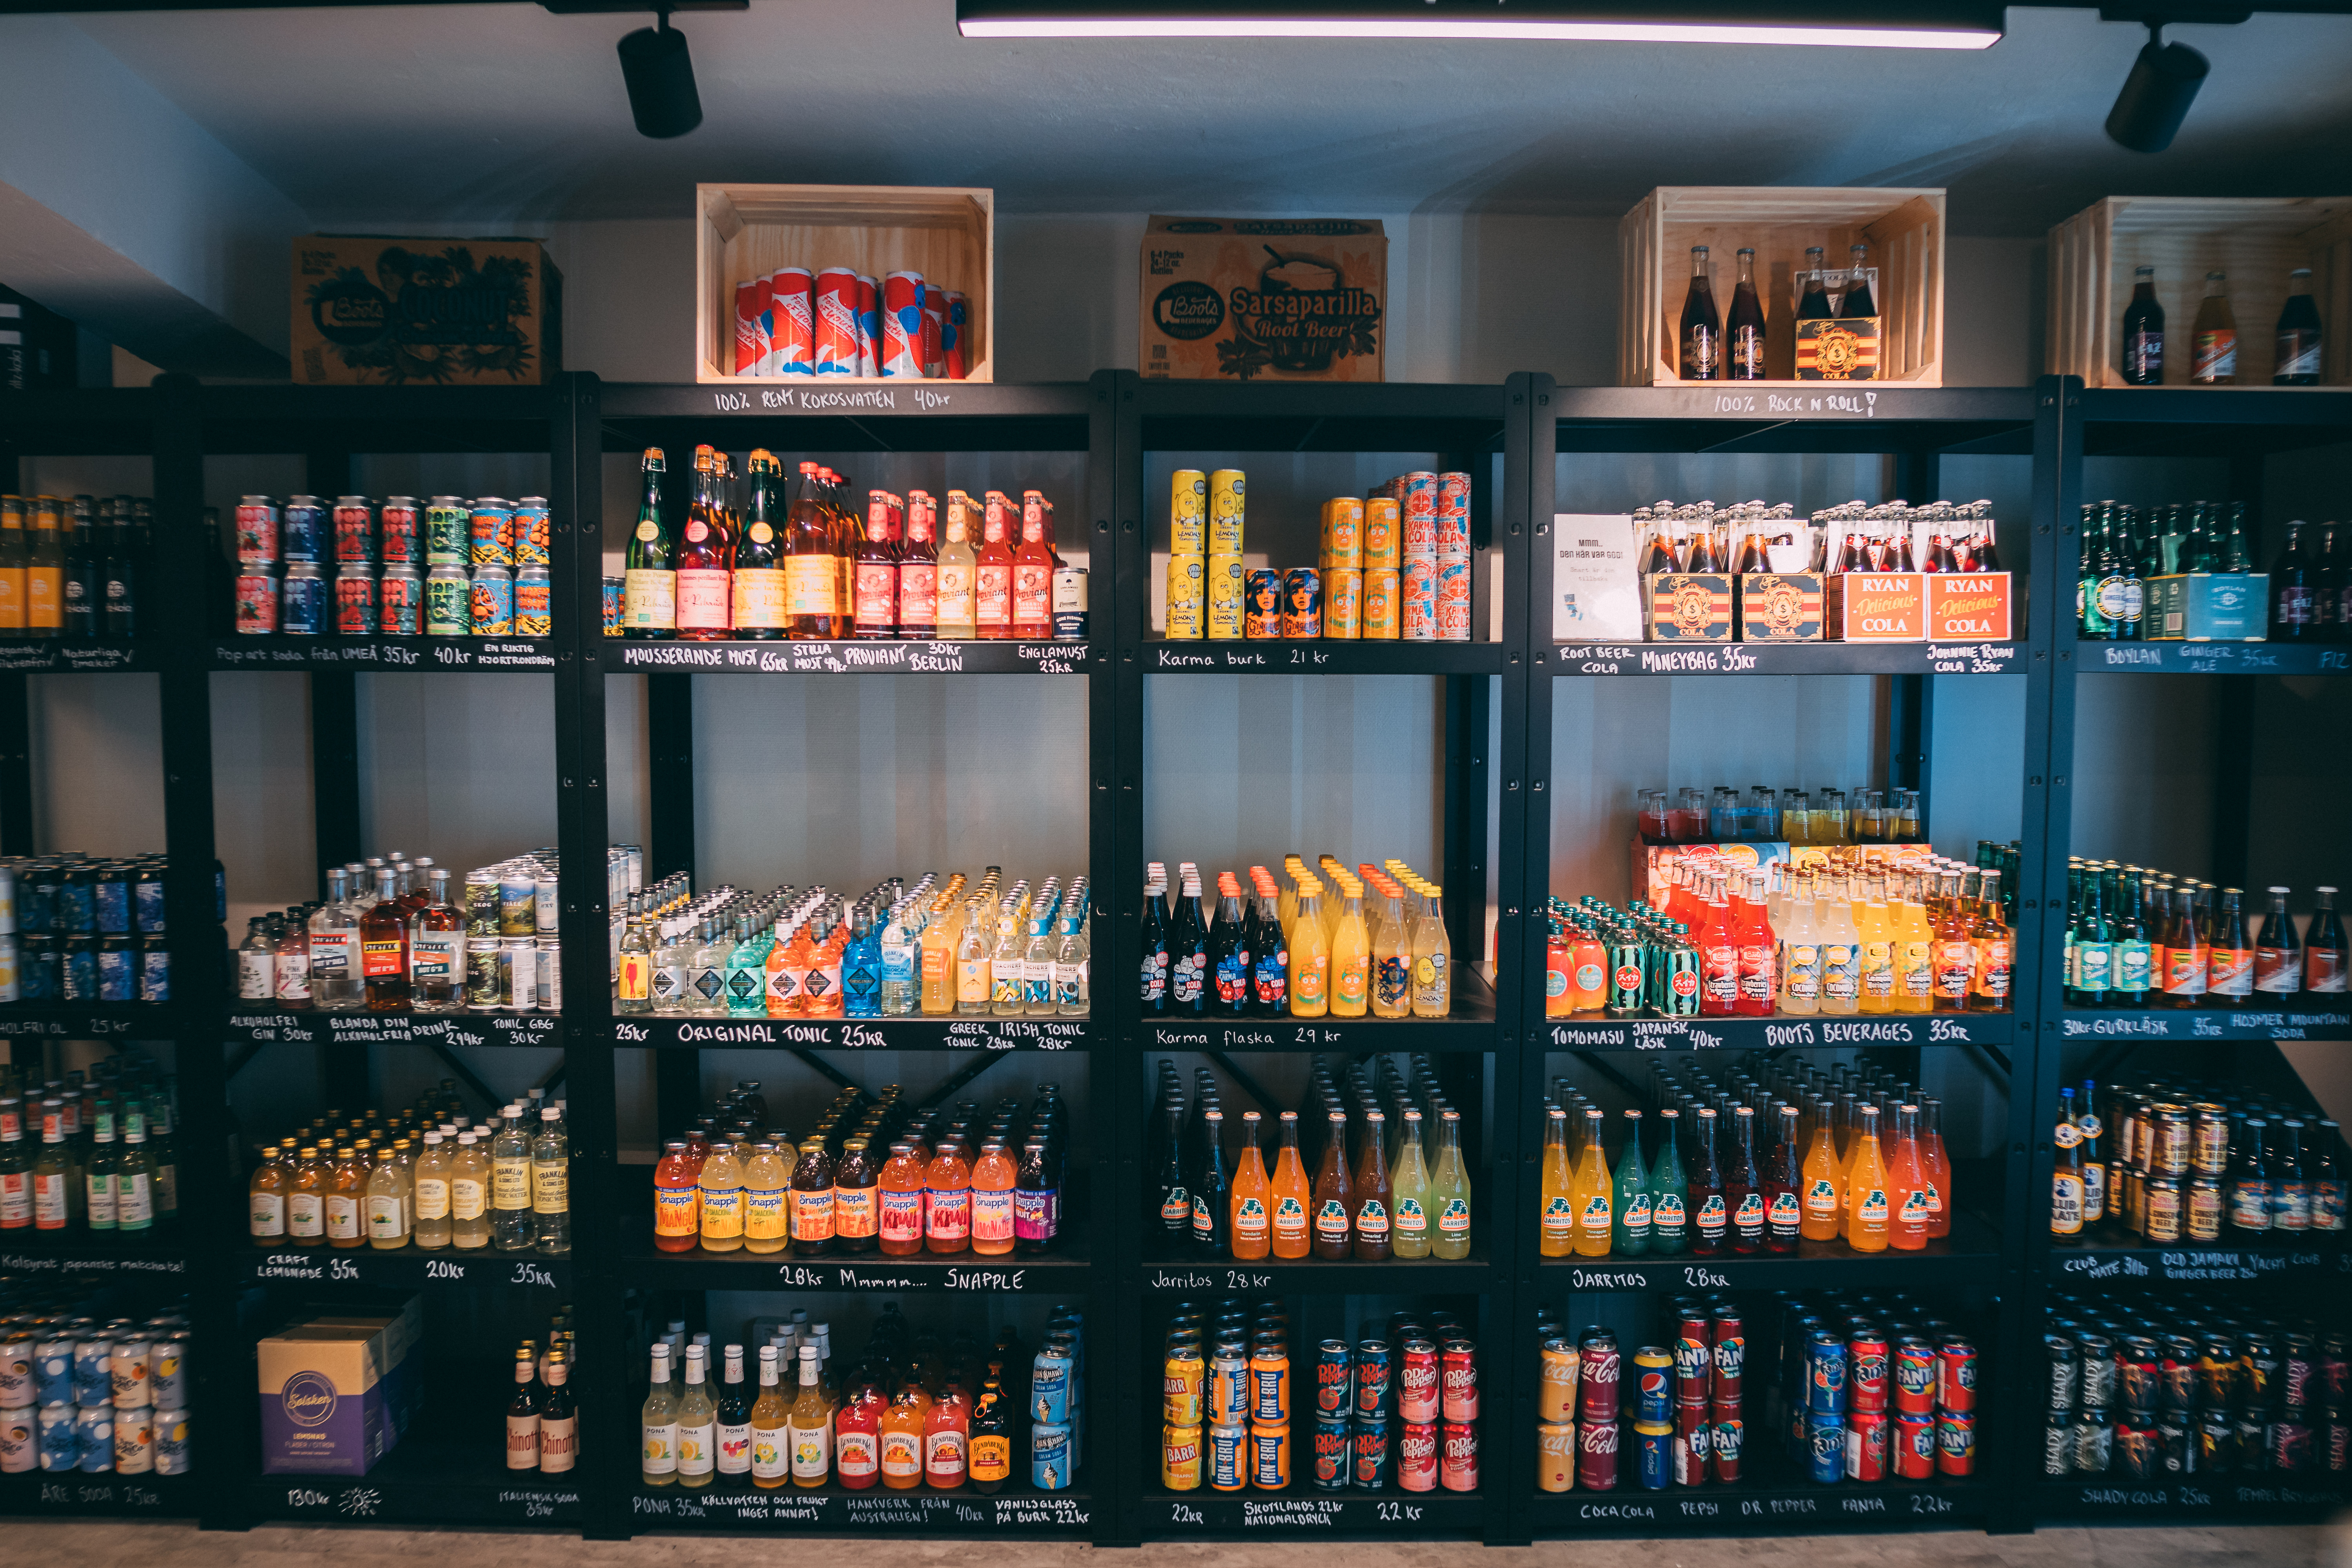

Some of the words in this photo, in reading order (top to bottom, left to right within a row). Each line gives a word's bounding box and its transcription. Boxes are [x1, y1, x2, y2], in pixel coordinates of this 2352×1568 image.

[1164, 250, 1184, 259] Packs
[1174, 295, 1218, 315] Boots
[1233, 290, 1376, 319] Sarsaparilla
[1258, 321, 1300, 337] Root
[1304, 321, 1347, 337] Beer
[715, 394, 750, 411] 100%
[762, 389, 794, 408] RENT
[914, 390, 951, 411] 40kr
[1715, 396, 1755, 413] 100%
[1768, 395, 1803, 413] ROCK
[1810, 397, 1821, 412] N
[1826, 392, 1877, 418] ROLL!
[1409, 520, 1434, 530] KARMA
[1862, 579, 1910, 592] RYAN
[1944, 579, 1994, 593] RYAN
[1857, 595, 1914, 617] Delicious
[216, 647, 242, 663] Pop
[245, 648, 268, 660] art
[273, 650, 305, 661] soda
[311, 646, 339, 661] från
[342, 644, 378, 661] UMEÅ
[383, 645, 420, 664] 35kr
[434, 647, 472, 664] 40kr
[502, 644, 534, 653] RIKTIG
[792, 644, 832, 657] STILLA
[844, 644, 907, 666] PROVIANT
[928, 642, 962, 655] 30kr
[1018, 645, 1088, 661] ENGLAMUST
[1560, 646, 1592, 661] ROOT
[1595, 646, 1635, 660] BEER
[1927, 644, 1978, 661] JOHNNIE
[1980, 644, 2014, 659] RYAN
[2178, 645, 2235, 657] GINGER
[479, 655, 555, 666] HJORTRONDRÖM
[625, 648, 723, 666] MOUSSERANDE
[728, 648, 758, 666] MUST
[908, 653, 962, 672] BERLIN
[1159, 649, 1214, 667] Karma
[1227, 651, 1266, 665] burk
[1290, 649, 1304, 664] 21
[1314, 651, 1329, 663] kr
[1642, 650, 1718, 673] MONEYBAG
[1722, 646, 1757, 671] 35kr
[2104, 647, 2162, 666] BOYLAN
[1581, 662, 1618, 674] COLA
[1934, 661, 1965, 673] COLA
[1971, 659, 2004, 673] 35kr
[2190, 659, 2217, 671] ALE
[1617, 973, 1639, 982] スイカ
[229, 1016, 299, 1027] ALKOHOLFRI
[329, 1018, 379, 1030] BLANDA
[383, 1016, 409, 1029] DIN
[492, 1018, 524, 1029] TONIC
[529, 1018, 554, 1029] GBG
[2091, 1016, 2170, 1036] GURKLÄSK
[2289, 1013, 2350, 1026] MOUNTAIN
[252, 1028, 276, 1040] GIN
[282, 1027, 314, 1041] 30kr
[412, 1020, 460, 1036] DRINK
[615, 1024, 650, 1041] 25kr
[678, 1023, 777, 1043] ORIGINAL
[782, 1024, 833, 1043] TONIC
[841, 1024, 887, 1047] 25KR
[949, 1023, 989, 1035] GREEK
[1000, 1022, 1040, 1038] IRISH
[1042, 1023, 1085, 1036] TONIC
[1632, 1021, 1689, 1036] JAPANSK
[1765, 1022, 1815, 1047] BOOTS
[1822, 1023, 1914, 1042] BEVERAGES
[1929, 1019, 1971, 1042] 35KR
[2270, 1027, 2307, 1039] SODA
[333, 1029, 412, 1043] ALKOHOLFRIA
[445, 1032, 485, 1046] 299kr
[943, 1036, 980, 1048] TONIC
[1156, 1029, 1208, 1044] Karma
[1224, 1030, 1274, 1046] flaska
[1295, 1027, 1316, 1044] 29
[1324, 1029, 1341, 1043] kr
[1551, 1026, 1624, 1045] TOMOMASU
[1689, 1029, 1723, 1050] 40kr
[1635, 1036, 1667, 1050] LÄSK
[660, 1193, 694, 1206] Snapple
[704, 1195, 739, 1209] Snapple
[884, 1209, 917, 1229] KIWI
[1236, 1217, 1265, 1227] JARRITOS
[1, 1254, 59, 1272] Kolsyrat
[62, 1258, 118, 1273] japanskt
[267, 1255, 310, 1265] CRAFT
[2063, 1256, 2098, 1272] CLUB
[257, 1265, 323, 1279] LEMONADE
[426, 1260, 465, 1279] 20kr
[511, 1262, 557, 1289] 35KR
[2088, 1260, 2120, 1280] MATE
[779, 1265, 824, 1286] 28kr
[944, 1268, 1025, 1290] SNAPPLE
[1151, 1269, 1212, 1289] Jarritos
[1227, 1270, 1248, 1289] 28
[1253, 1274, 1271, 1288] kr
[1573, 1269, 1647, 1288] JARRITOS
[1684, 1267, 1731, 1287] 28KR
[2051, 1362, 2065, 1410] SHADY
[1643, 1399, 1664, 1408] pepsi
[840, 1437, 871, 1450] BUNDABERG
[1167, 1445, 1196, 1462] BARR
[701, 1495, 768, 1507] KÄLLVATTEN
[773, 1496, 794, 1506] OCH
[797, 1497, 829, 1506] FRUKT
[847, 1499, 911, 1510] HANTVERK
[921, 1497, 950, 1510] FRÅN
[996, 1499, 1077, 1510] VANILJGLASS
[1244, 1501, 1314, 1515] SKOTTLANDS
[1318, 1501, 1343, 1513] 22kr
[1580, 1504, 1619, 1519] COCA
[1620, 1505, 1655, 1519] COLA
[1679, 1501, 1719, 1516] PEPSI
[1741, 1501, 1763, 1515] DR
[1770, 1499, 1817, 1513] PEPPER
[1841, 1497, 1886, 1513] FANTA
[1910, 1494, 1954, 1514] 22kr
[737, 1507, 769, 1519] INGET
[775, 1507, 819, 1521] ANNAT!
[850, 1511, 929, 1524] AUSTRALIEN!
[996, 1510, 1012, 1524] PÅ
[1018, 1511, 1050, 1523] BURK
[1056, 1511, 1090, 1524] 22kr
[1245, 1513, 1331, 1526] NATIONALDRYCK
